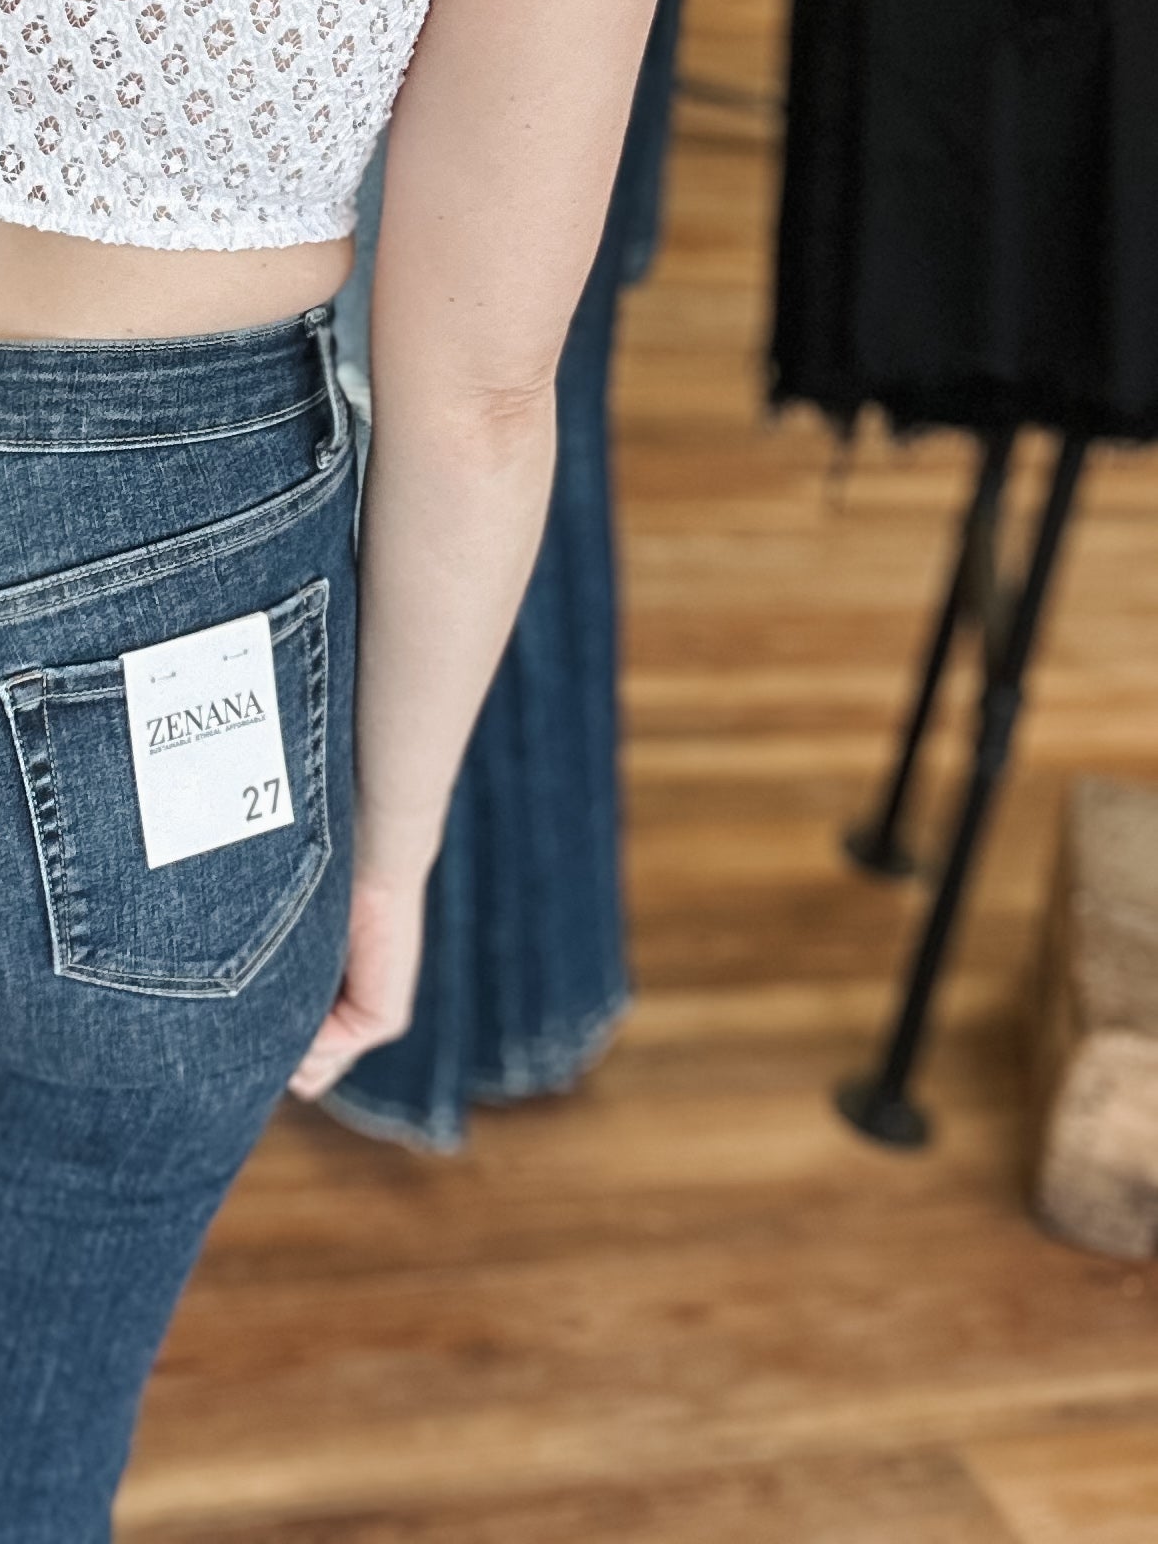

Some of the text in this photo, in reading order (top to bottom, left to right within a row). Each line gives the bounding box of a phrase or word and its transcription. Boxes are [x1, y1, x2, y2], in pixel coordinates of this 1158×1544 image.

[146, 689, 264, 747] ZENANA
[150, 738, 192, 755] SUSTAINABLE
[242, 777, 281, 822] 27
